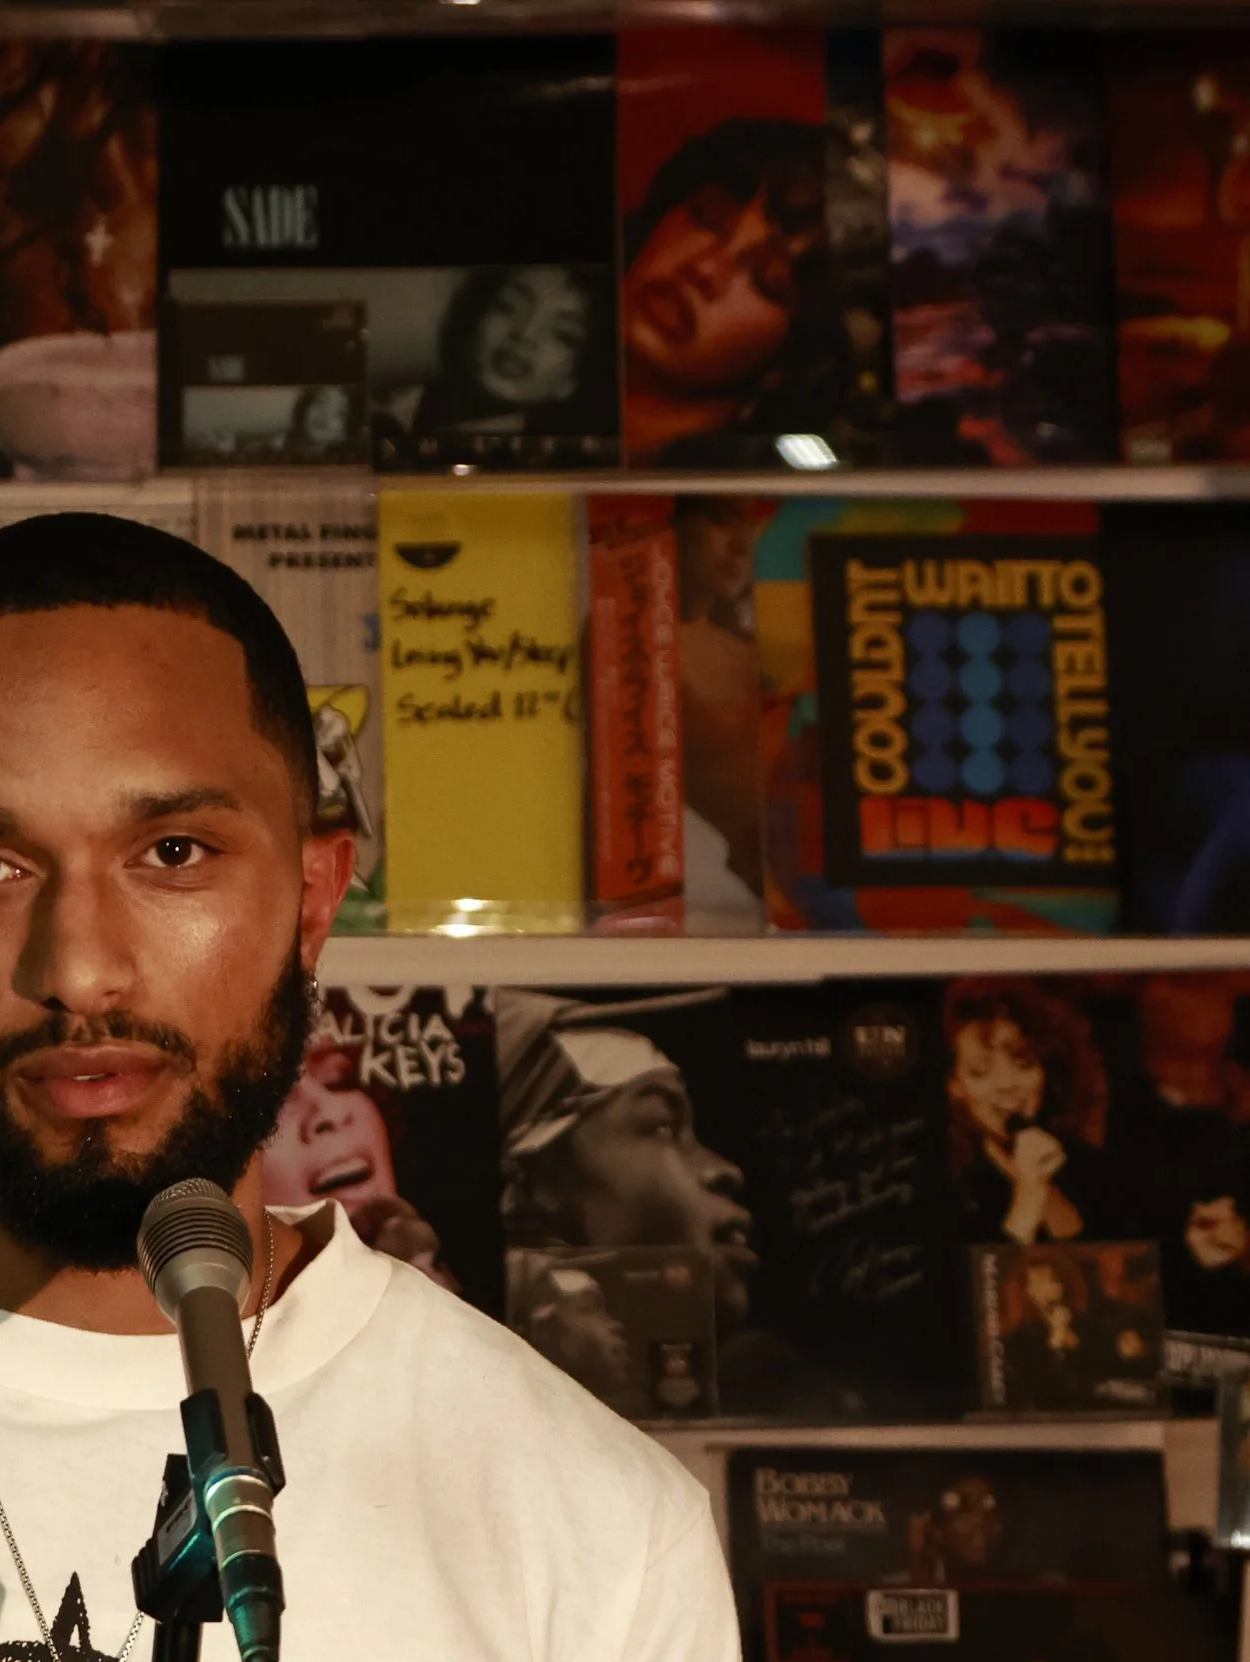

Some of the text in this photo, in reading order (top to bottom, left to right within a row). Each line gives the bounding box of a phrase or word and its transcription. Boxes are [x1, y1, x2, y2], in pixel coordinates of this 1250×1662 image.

[222, 184, 319, 248] SADE
[231, 523, 312, 541] METAL
[316, 1010, 456, 1046] ALICIA
[359, 1040, 468, 1093] KEYS
